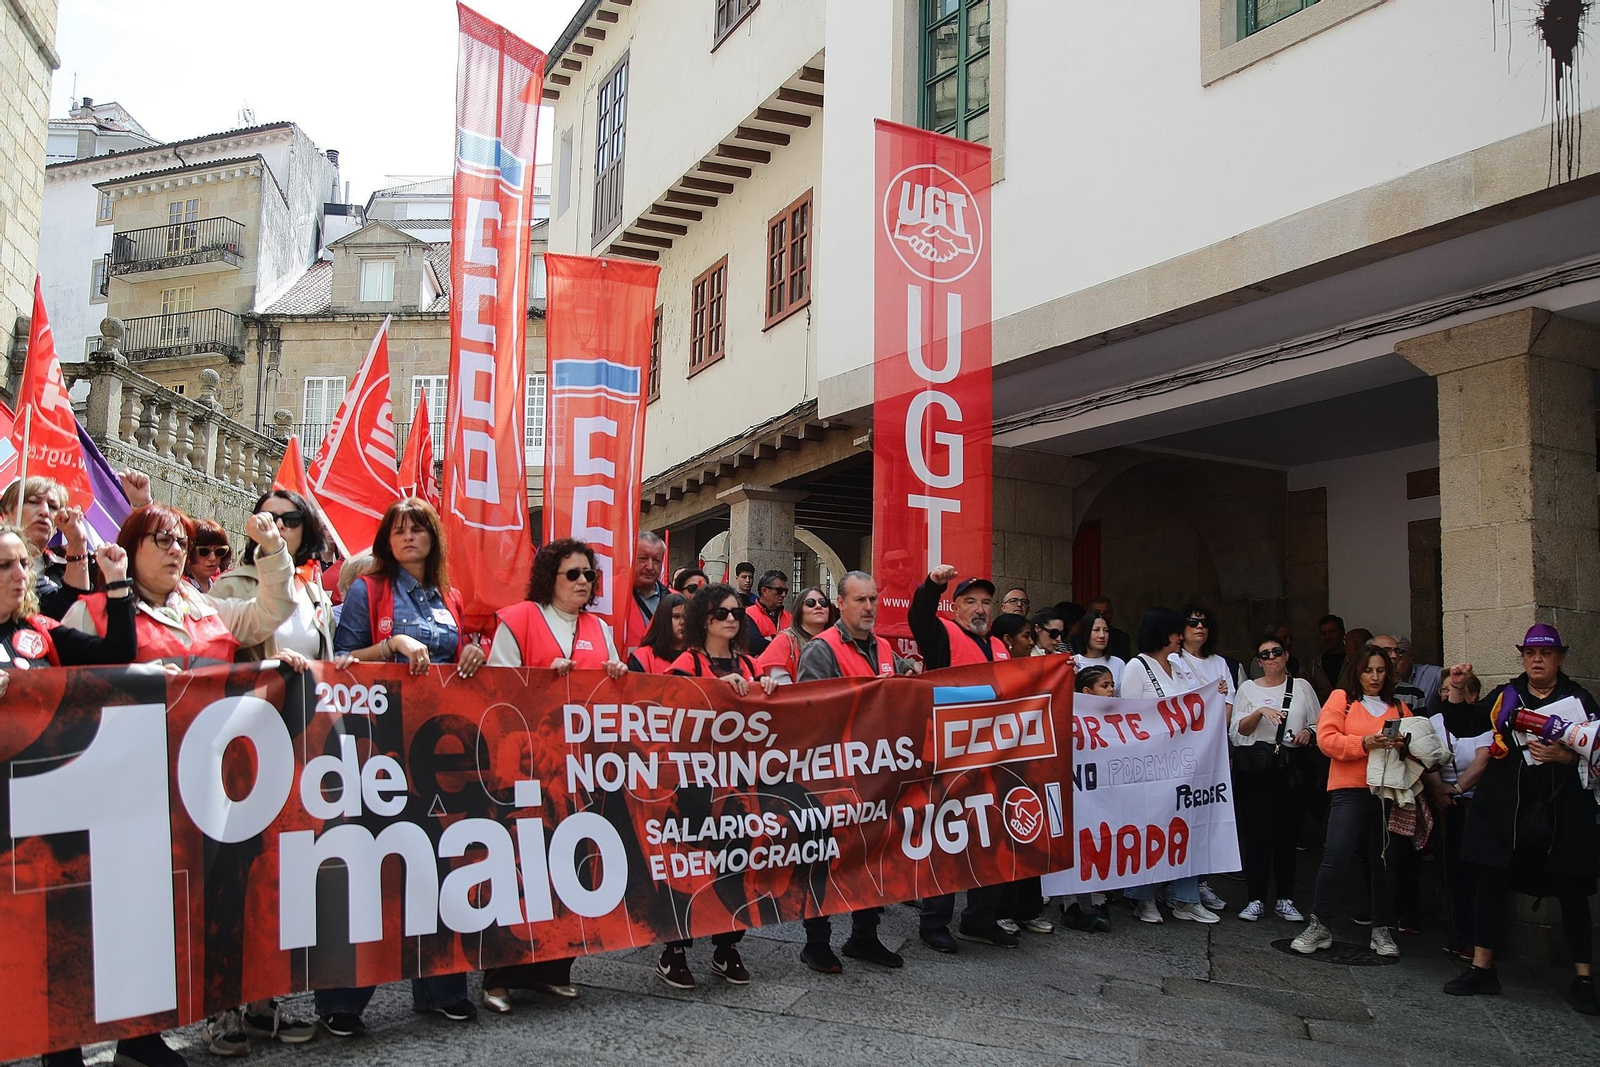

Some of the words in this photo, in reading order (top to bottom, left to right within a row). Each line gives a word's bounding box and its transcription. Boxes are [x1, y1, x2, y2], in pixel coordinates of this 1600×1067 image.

[899, 180, 968, 237] UGT
[905, 284, 964, 576] UGT
[315, 682, 389, 715] 2026
[1158, 693, 1206, 738] NO
[563, 704, 778, 748] DEREITOS,
[944, 709, 1045, 759] CCOO
[300, 734, 408, 820] de
[566, 752, 658, 793] NON
[668, 736, 922, 789] TRINCHEIRAS.
[1108, 747, 1198, 788] PODEMOS
[645, 812, 787, 845] SALARIOS,
[789, 799, 888, 833] VIVENDA
[901, 793, 995, 861] UGT
[279, 780, 628, 951] maio
[650, 855, 667, 881] E
[670, 837, 840, 879] DEMOCRACIA
[1079, 817, 1190, 882] NADA
